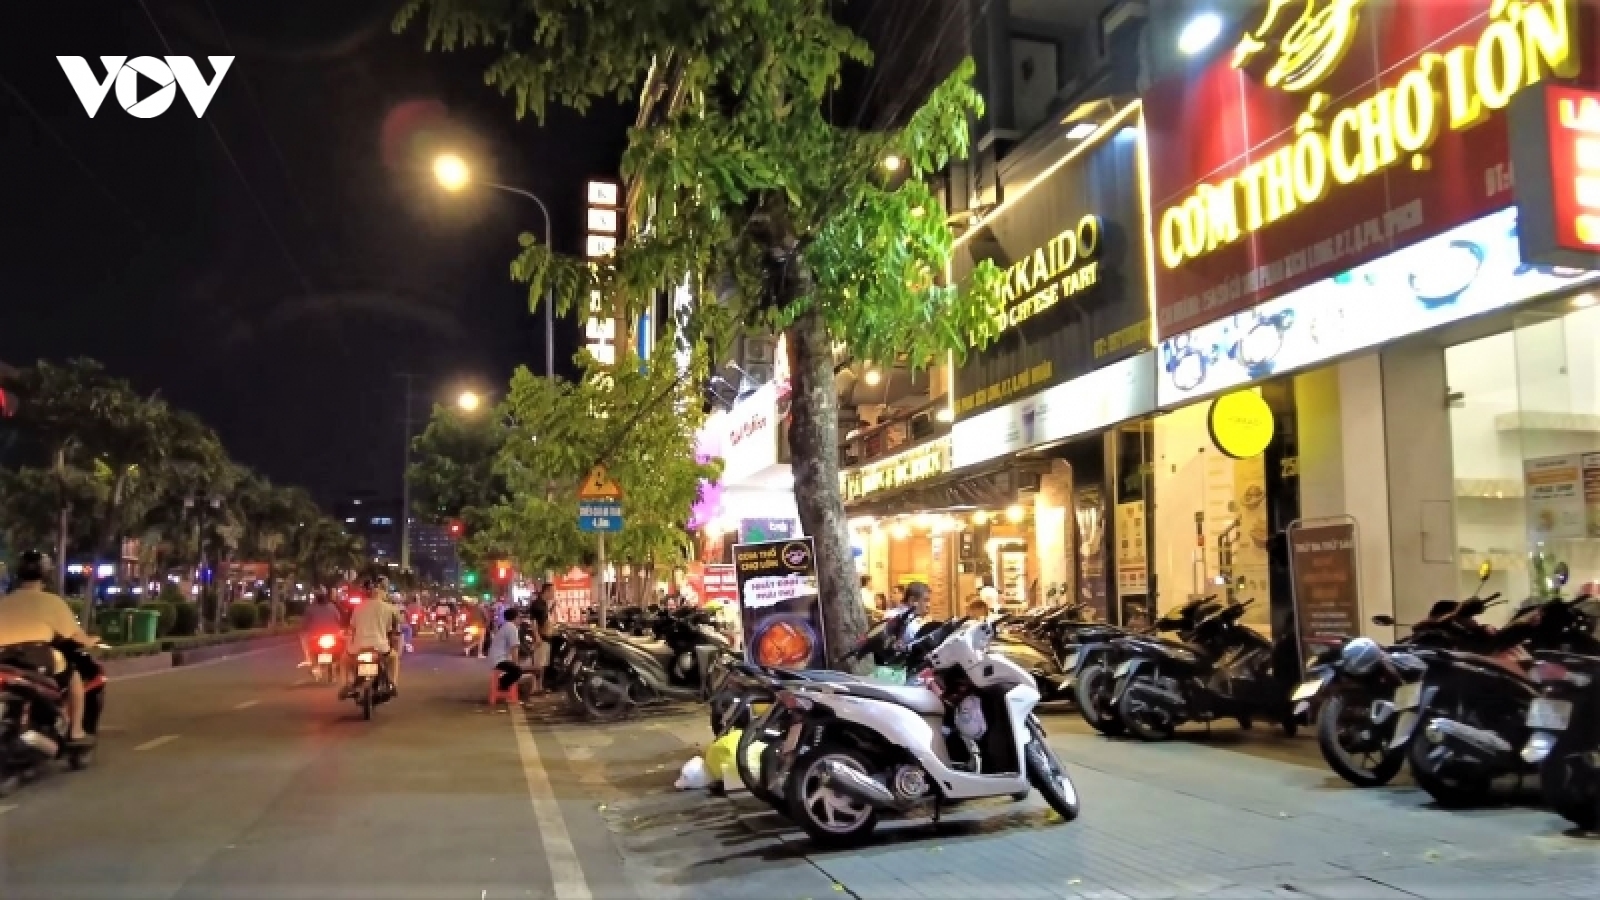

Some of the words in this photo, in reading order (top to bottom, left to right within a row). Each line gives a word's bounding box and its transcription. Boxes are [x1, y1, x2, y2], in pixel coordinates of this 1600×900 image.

[1160, 184, 1239, 268] CƠM
[1238, 92, 1329, 231] THỐ
[1330, 53, 1441, 184] CHỢ
[1446, 0, 1570, 128] LỚN
[1061, 261, 1099, 297] TART
